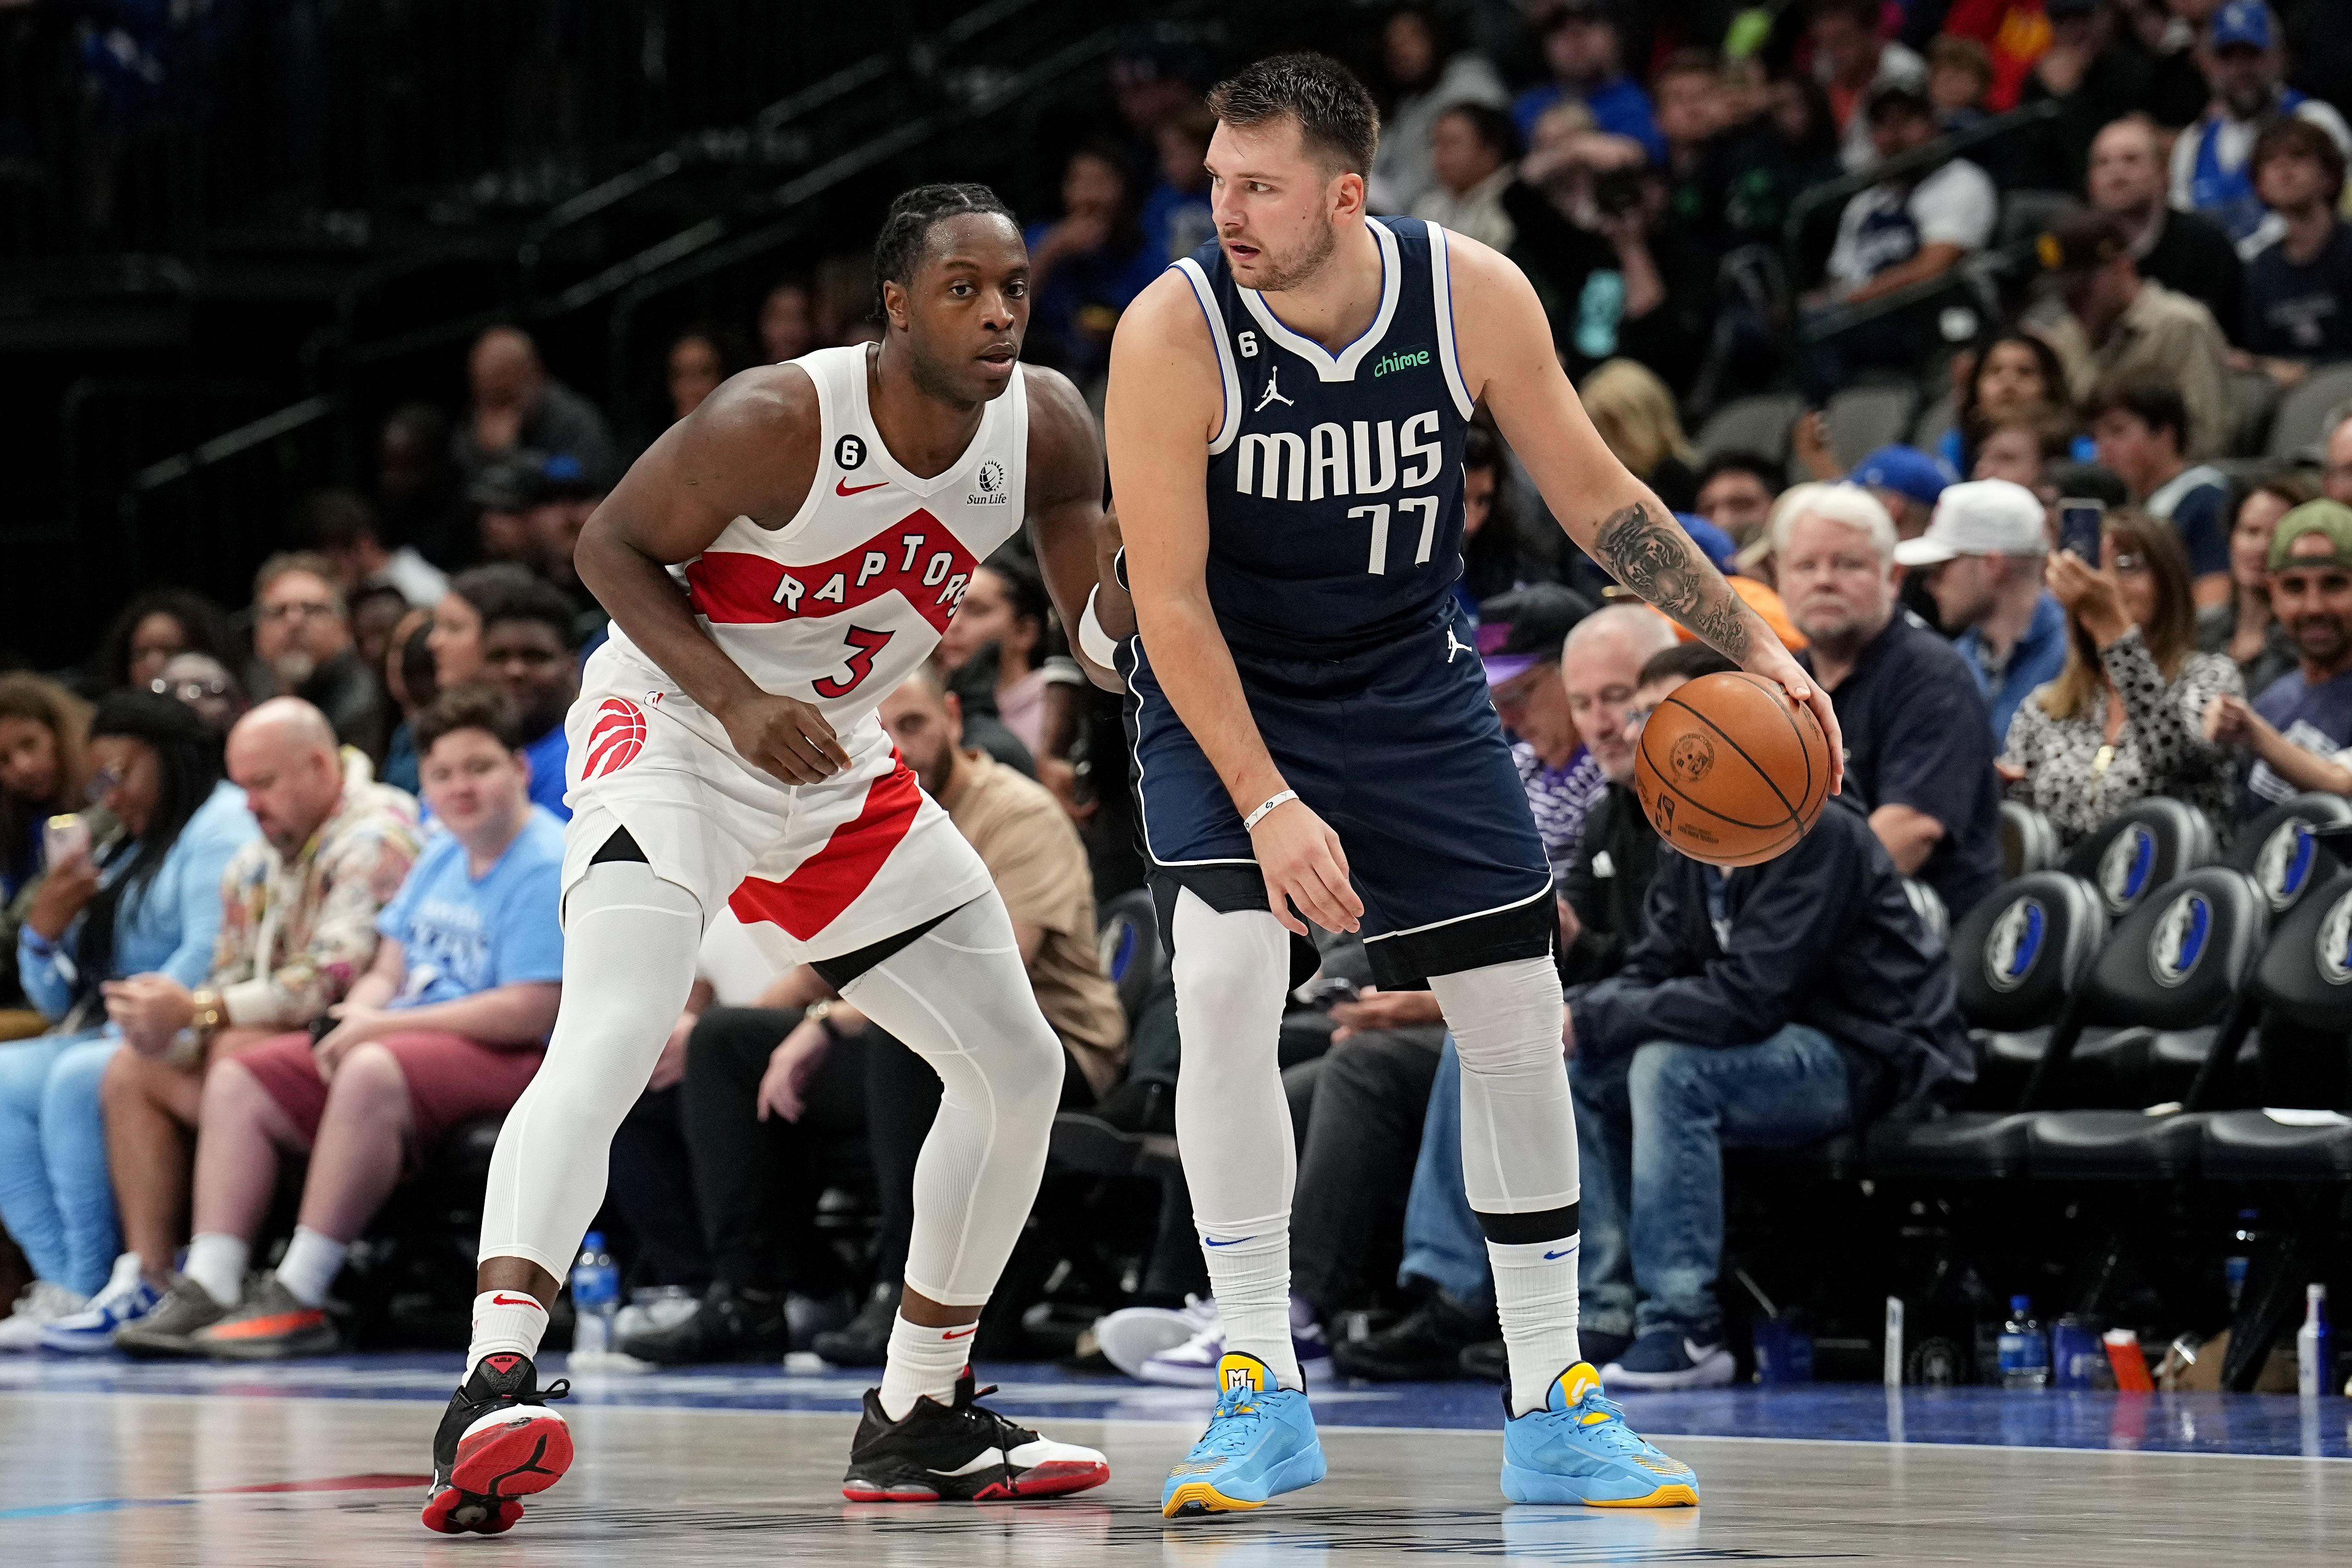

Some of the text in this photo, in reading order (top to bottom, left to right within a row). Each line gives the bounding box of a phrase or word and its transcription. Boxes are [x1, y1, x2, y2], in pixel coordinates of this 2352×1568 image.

[1238, 331, 1258, 357] 6
[1375, 351, 1430, 377] chime
[841, 440, 858, 466] 6
[967, 493, 1007, 505] Sun Life
[1348, 496, 1439, 575] 77
[772, 534, 970, 618] RAPTORS
[812, 624, 896, 699] 3
